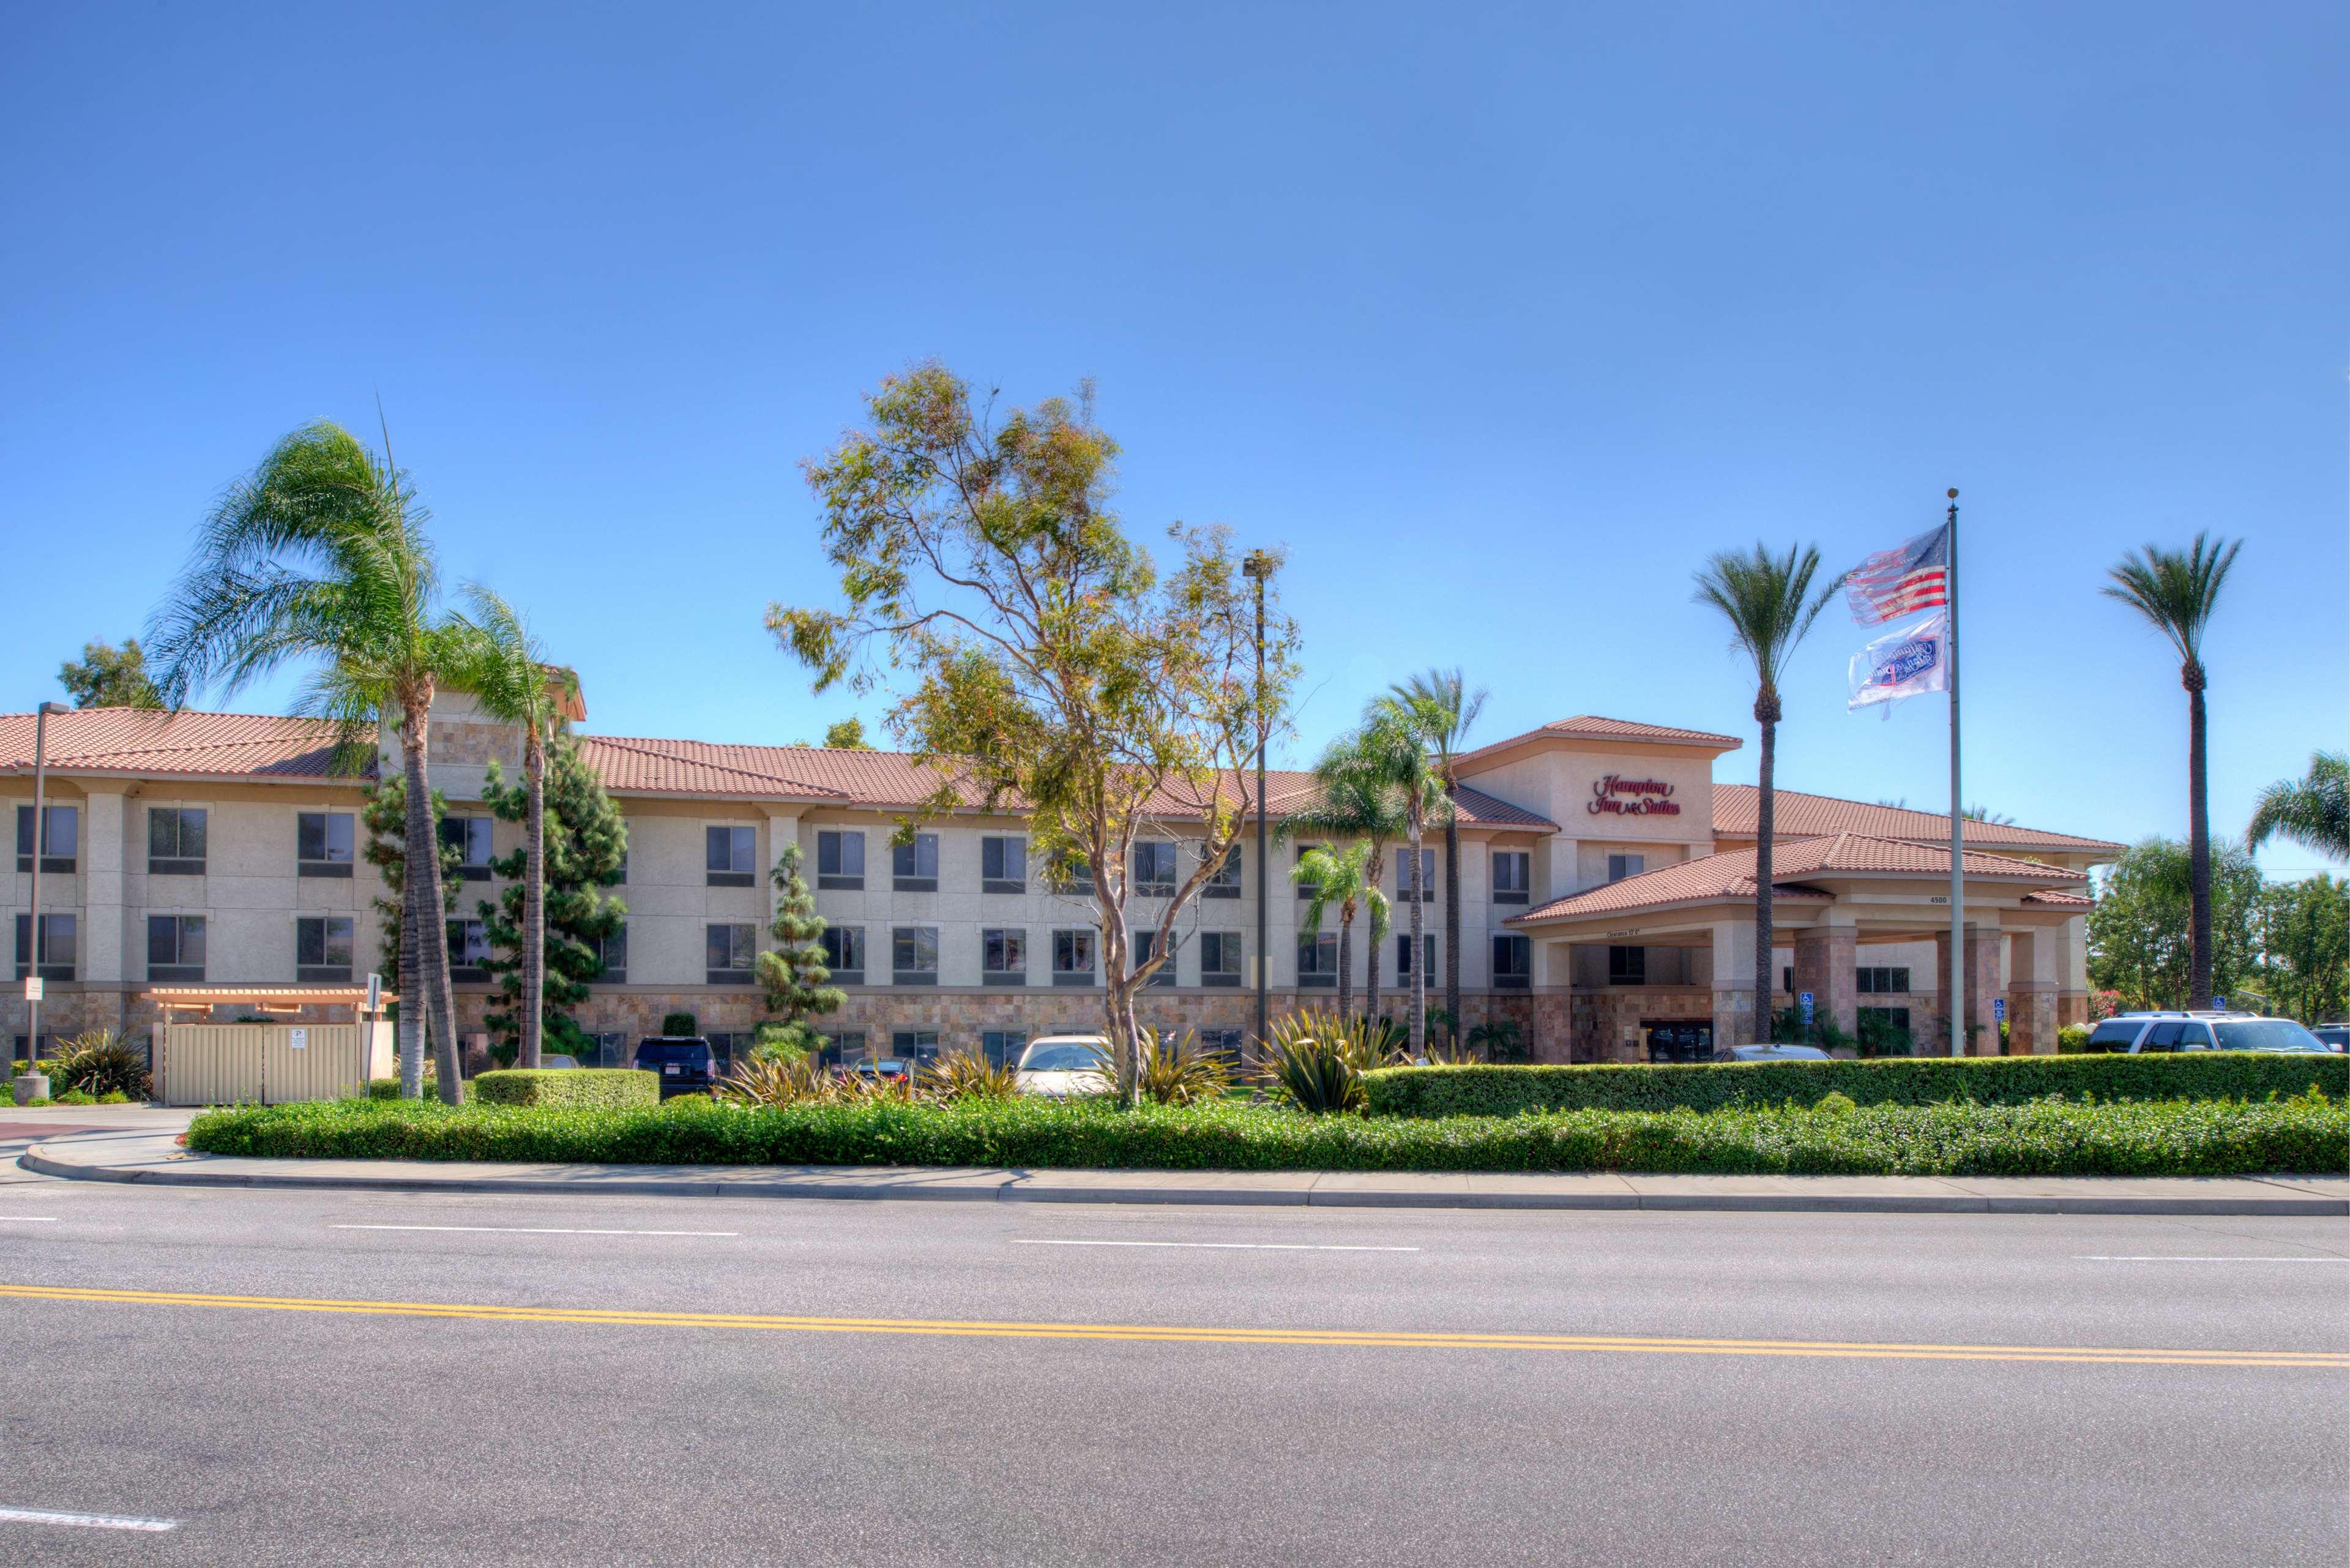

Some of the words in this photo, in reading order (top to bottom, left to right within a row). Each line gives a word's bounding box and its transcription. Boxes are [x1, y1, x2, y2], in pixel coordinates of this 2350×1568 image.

[1593, 774, 1675, 797] Hampton
[1587, 796, 1628, 815] Inn
[1628, 802, 1639, 816] &
[1637, 797, 1681, 815] Suites
